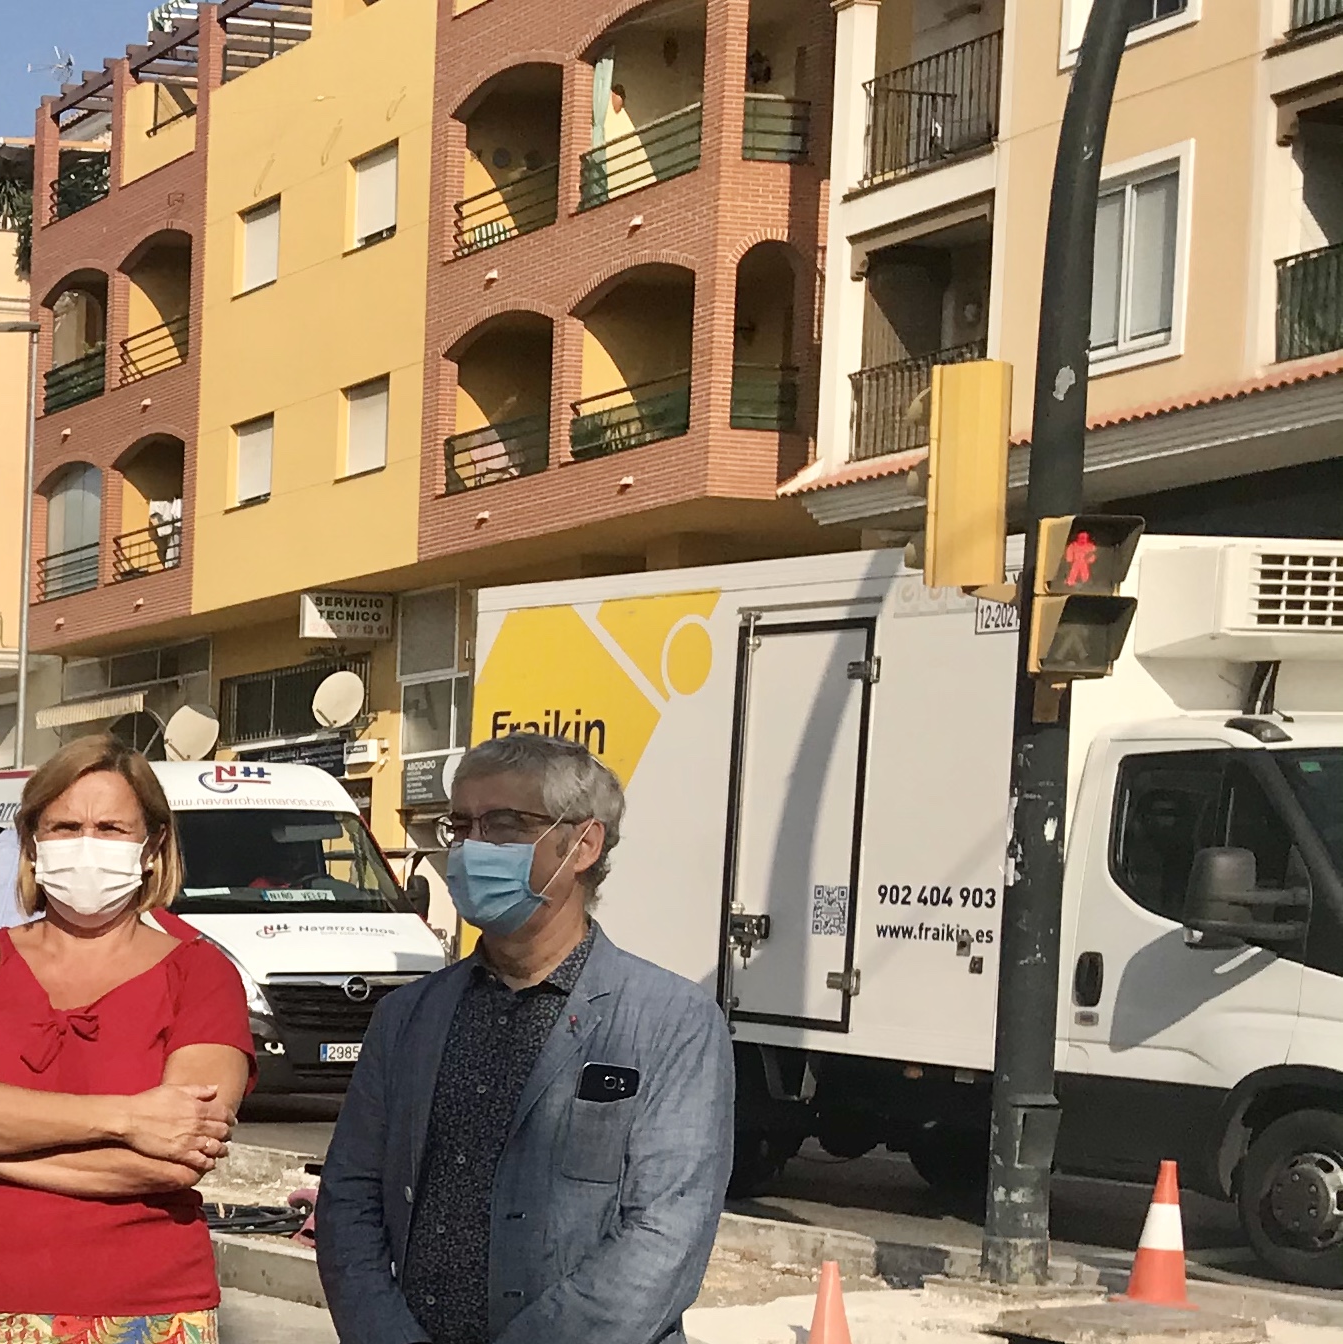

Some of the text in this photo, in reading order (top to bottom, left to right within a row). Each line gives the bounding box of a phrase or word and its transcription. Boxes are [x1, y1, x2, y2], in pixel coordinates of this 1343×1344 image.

[315, 596, 384, 609] SERVICIO
[318, 609, 382, 622] TECNICO
[877, 884, 996, 908] 902 404 903
[328, 1045, 359, 1060] 2985
